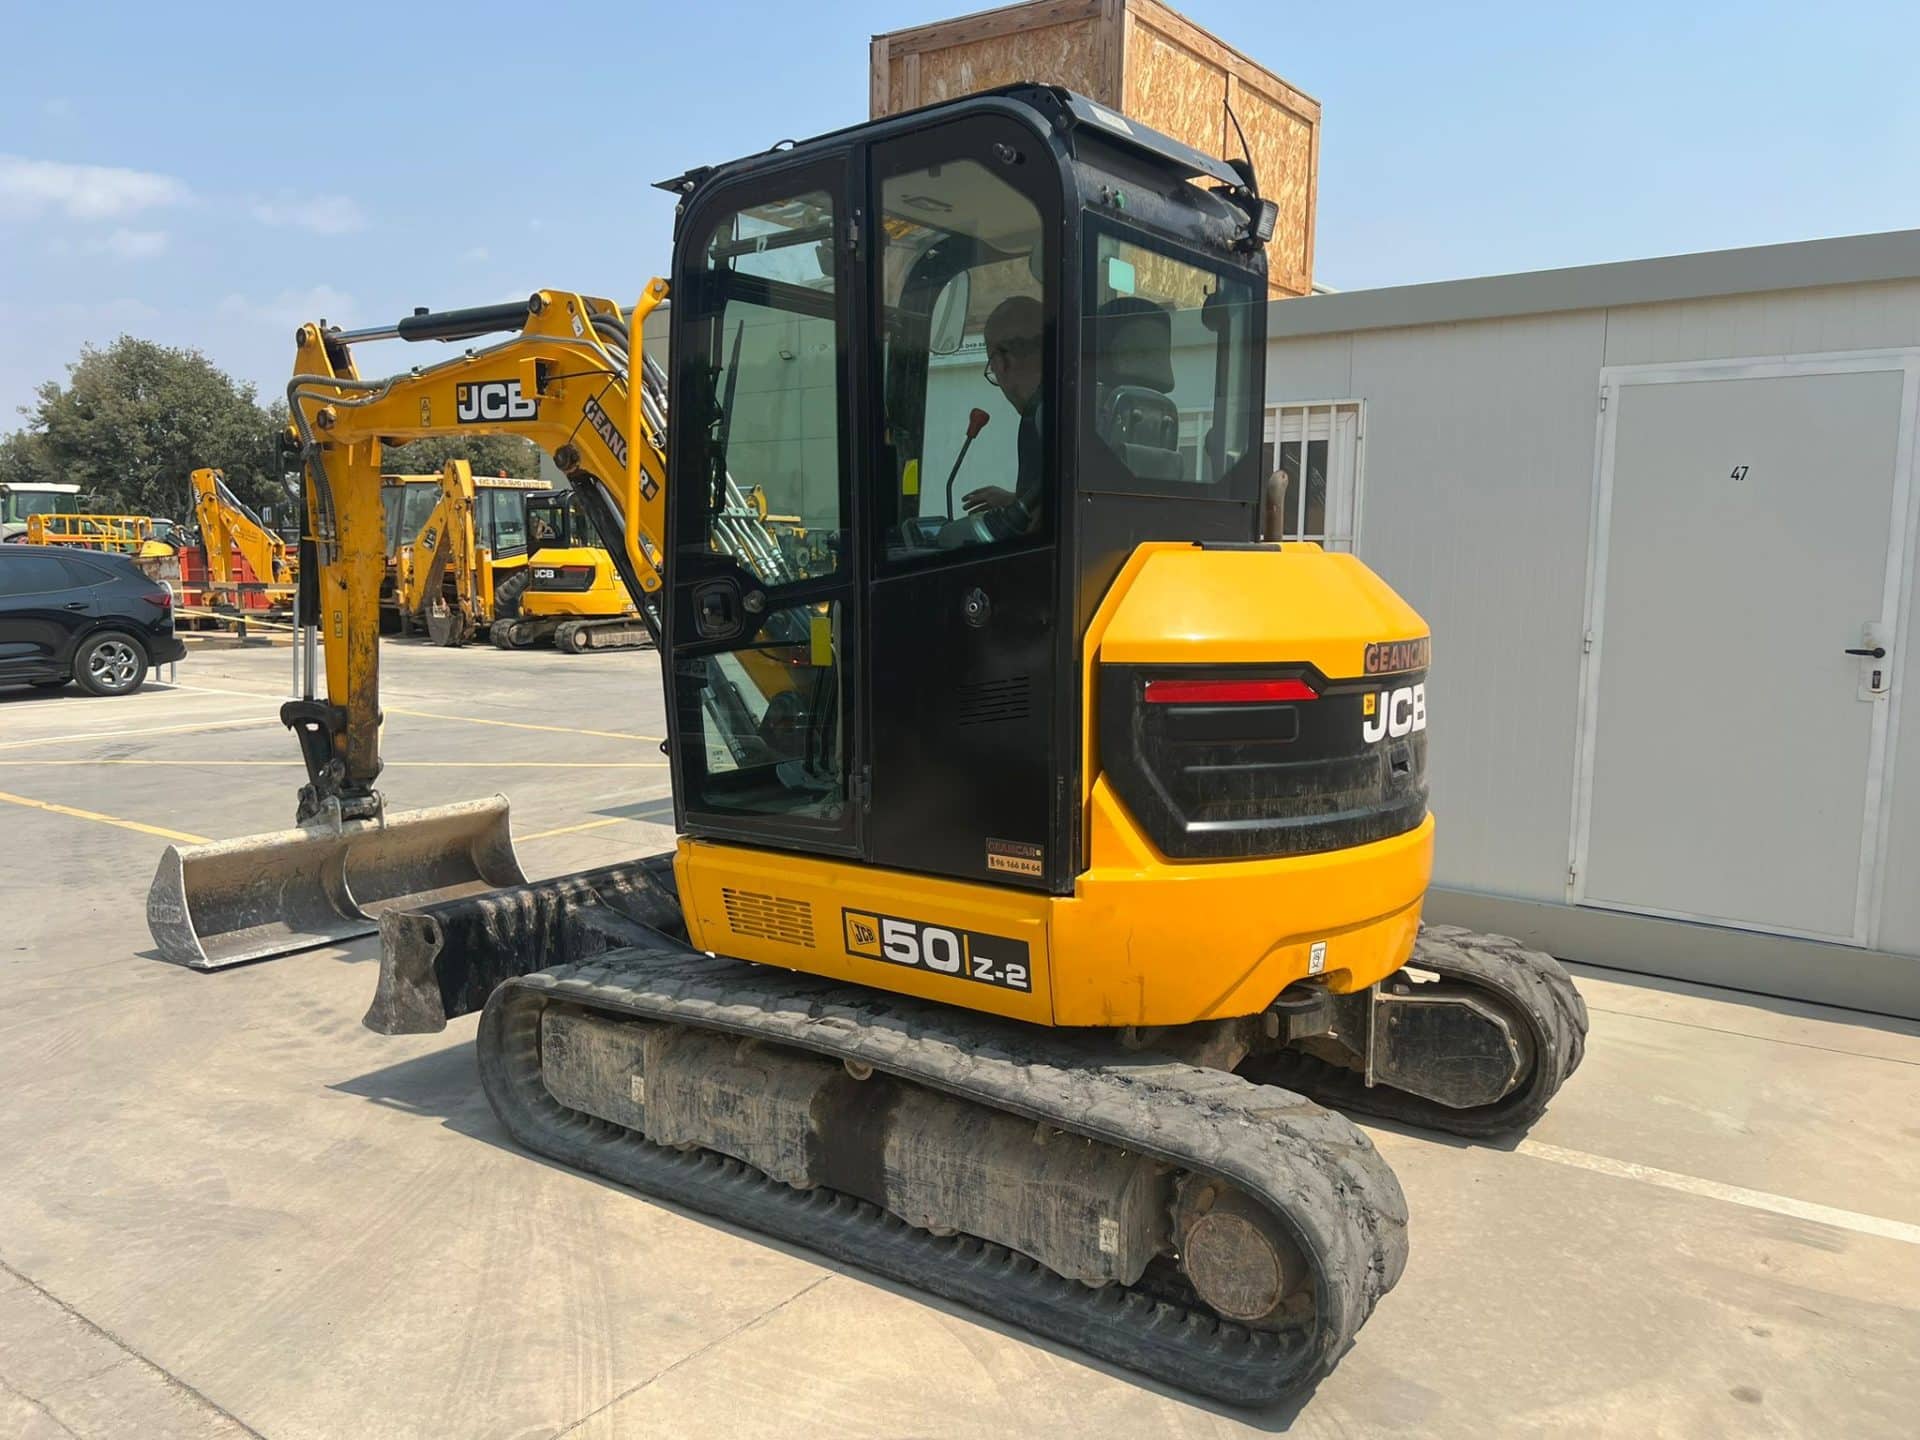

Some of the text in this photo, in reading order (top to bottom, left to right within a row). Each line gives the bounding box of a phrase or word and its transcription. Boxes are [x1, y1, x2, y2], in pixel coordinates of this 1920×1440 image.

[458, 383, 537, 420] JCB
[585, 400, 646, 490] GEANCR
[1730, 465, 1749, 481] 47
[534, 569, 554, 578] JCB
[1363, 683, 1427, 743] JCB
[854, 923, 874, 943] JCB
[882, 918, 1028, 988] 50 Z-2
